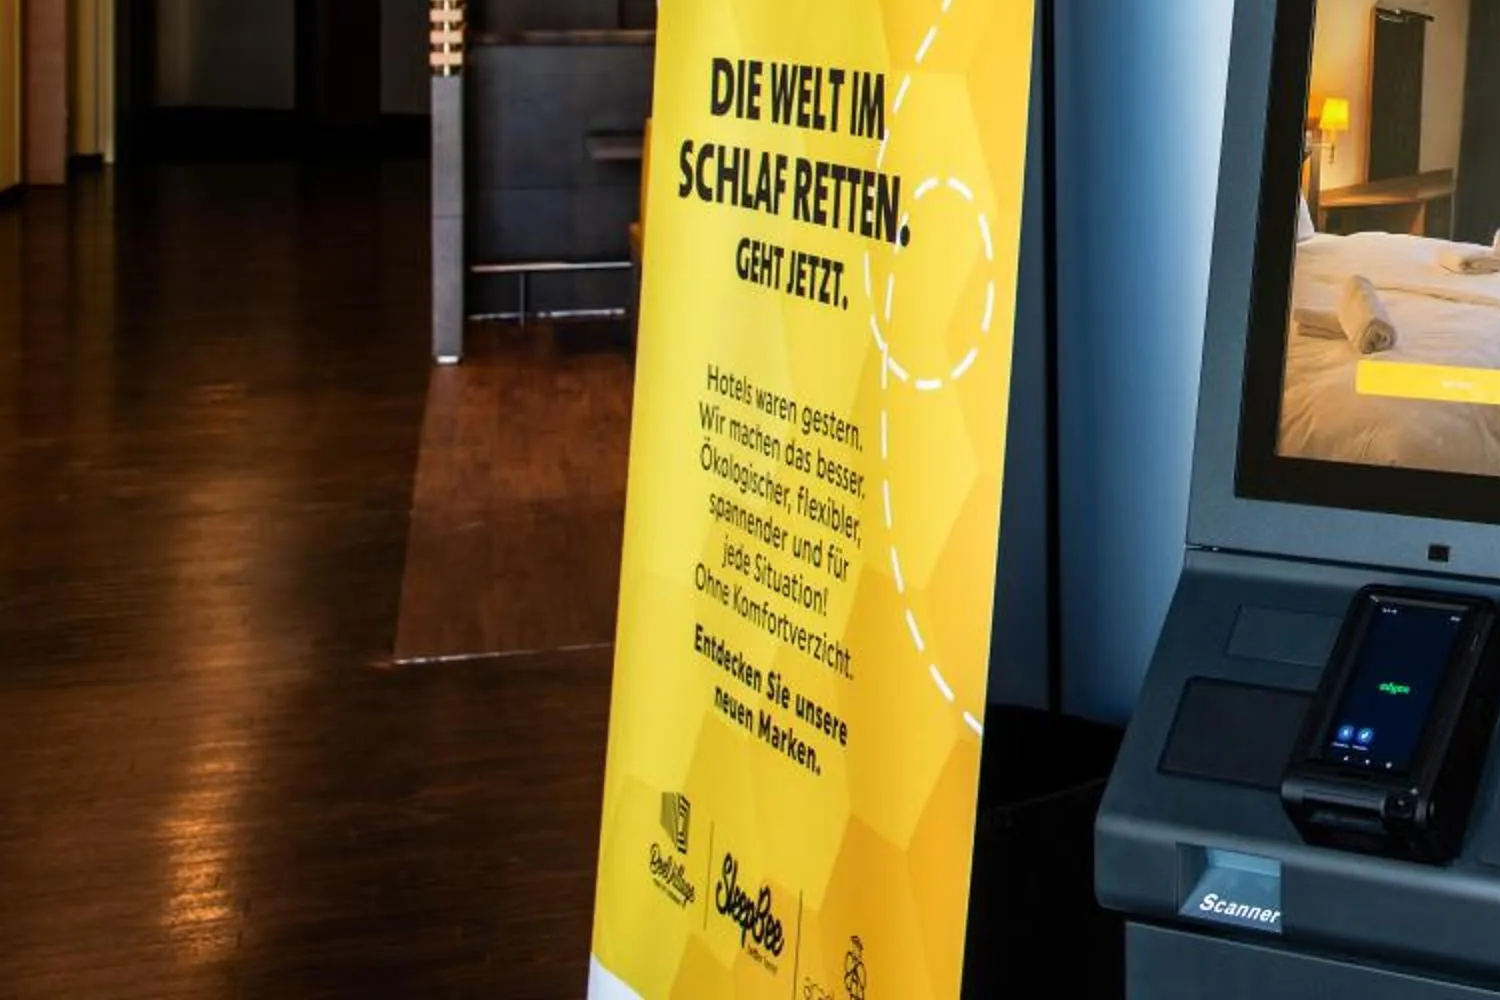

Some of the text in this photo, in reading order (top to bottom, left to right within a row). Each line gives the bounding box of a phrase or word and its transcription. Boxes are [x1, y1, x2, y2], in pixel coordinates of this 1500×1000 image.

[710, 57, 885, 141] DIE WELT IM
[678, 139, 910, 247] SCHLAF RETTEN.
[736, 237, 848, 311] GEHT JETZT.
[699, 401, 865, 500] Wir machen das besser.
[707, 364, 863, 453] Hotels waren gestern.
[700, 436, 862, 548] Ökologischer, flexibler,
[709, 493, 849, 582] spannender und für
[722, 534, 829, 617] jede Situation!
[695, 562, 854, 680] Ohne Komfortverzicht.
[694, 623, 848, 747] Entdecken Sie unsere
[714, 686, 821, 776] neuen Marken.
[716, 852, 785, 957] SleepBee
[1199, 893, 1281, 924] Scanner
